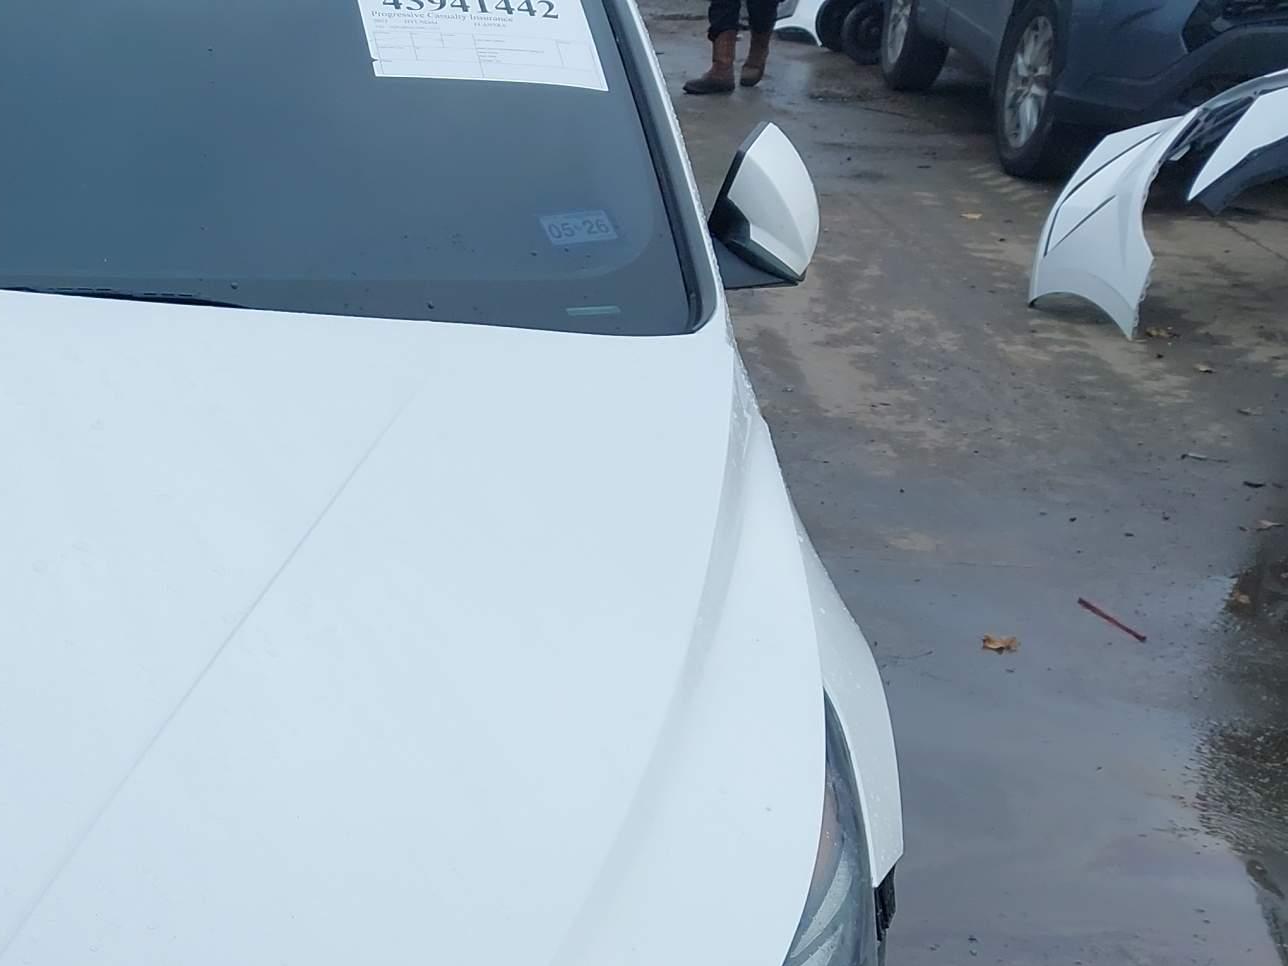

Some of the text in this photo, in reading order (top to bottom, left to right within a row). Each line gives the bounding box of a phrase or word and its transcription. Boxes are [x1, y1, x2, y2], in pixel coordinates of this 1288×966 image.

[371, 10, 513, 22] Progressive Casualty Insurance
